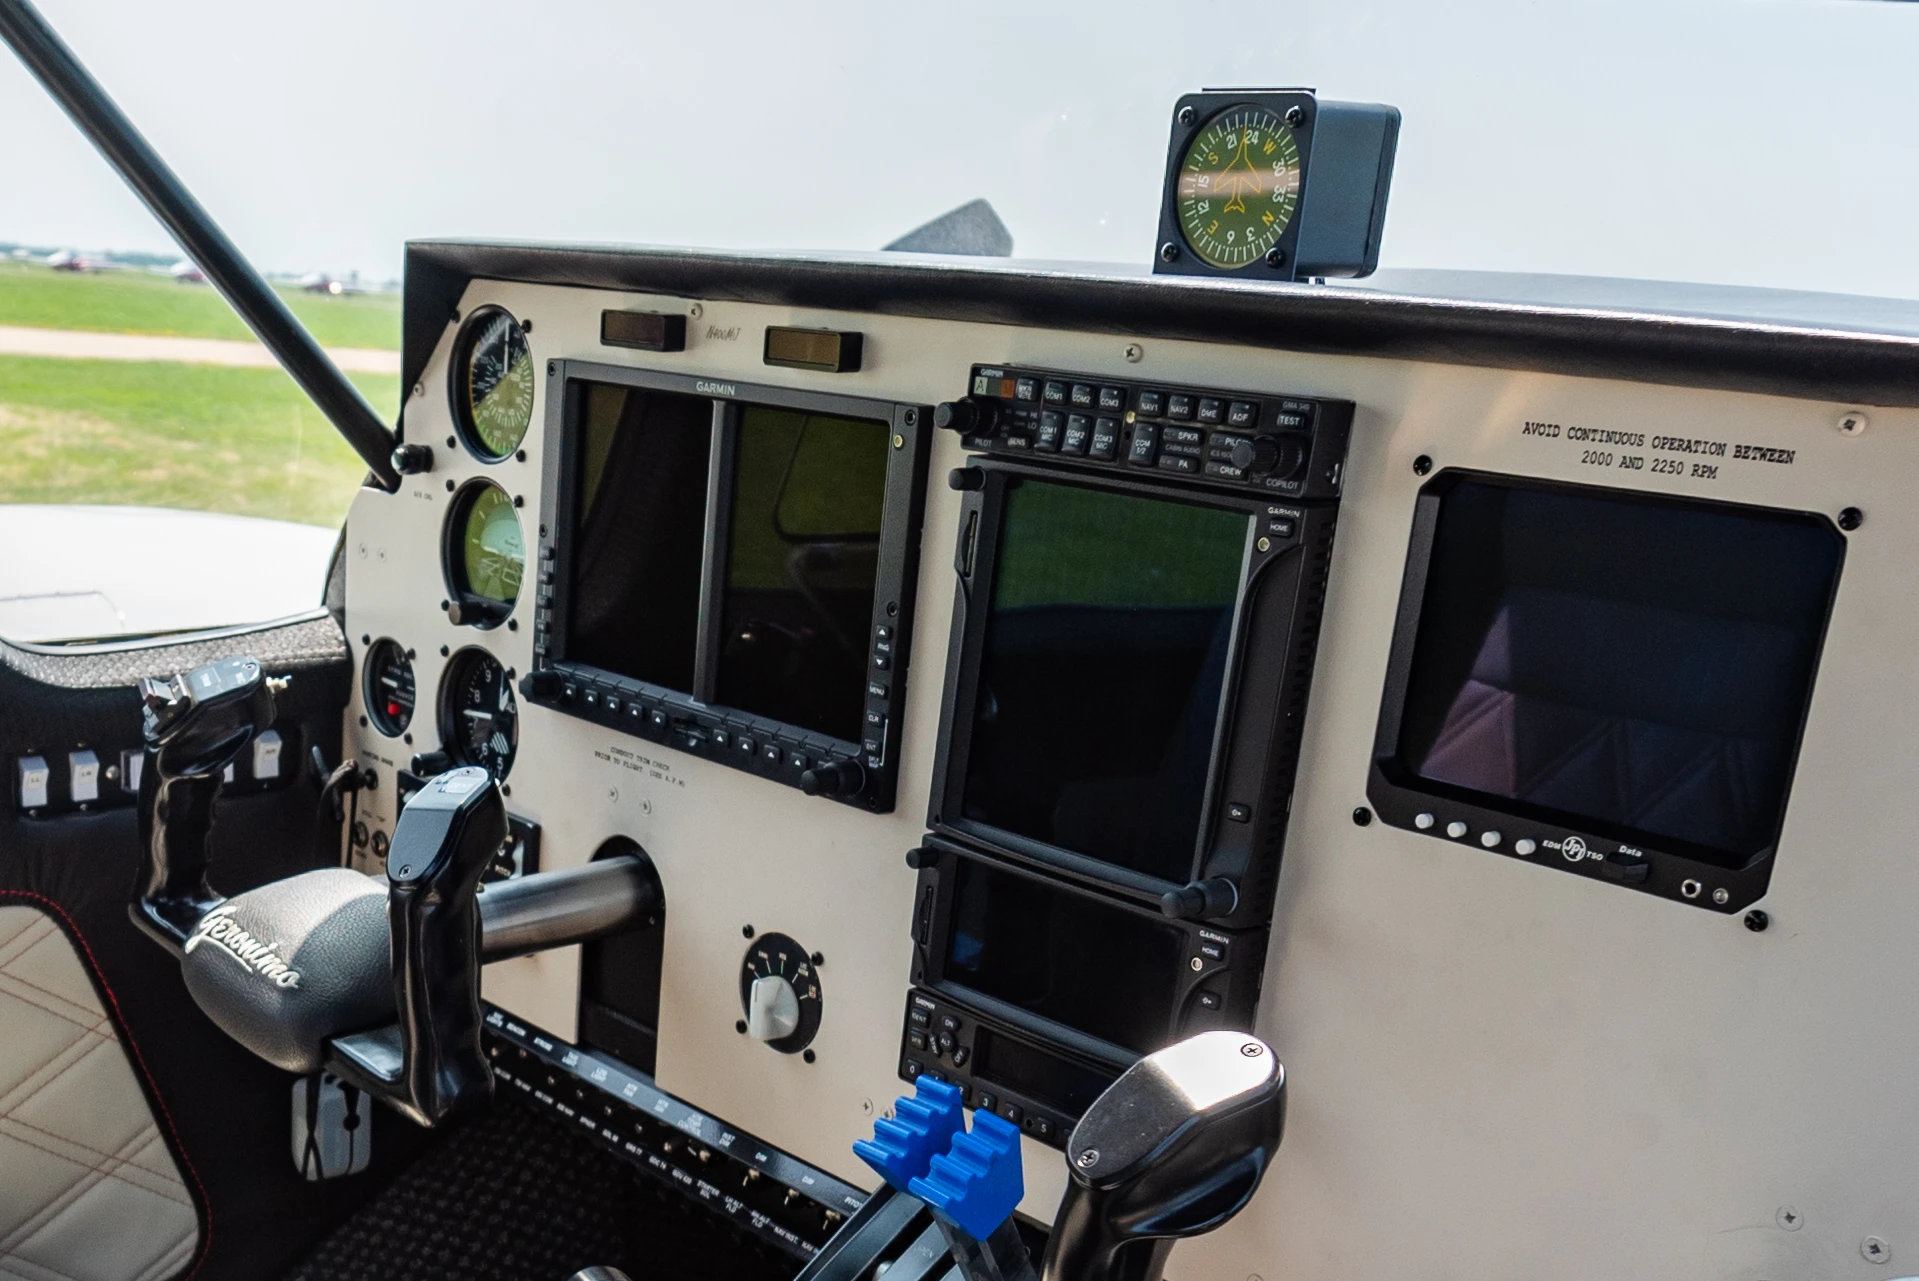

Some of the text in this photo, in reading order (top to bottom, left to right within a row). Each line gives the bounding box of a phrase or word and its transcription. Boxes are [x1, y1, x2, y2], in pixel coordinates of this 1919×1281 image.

[1226, 134, 1237, 149] 21
[1246, 130, 1259, 145] 24
[1263, 138, 1277, 154] W
[1208, 152, 1219, 165] S
[1272, 158, 1287, 177] 30
[1198, 175, 1210, 188] 15
[1272, 185, 1287, 203] 33
[1198, 199, 1210, 214] 12
[1262, 211, 1275, 226] N
[1208, 219, 1218, 234] E
[1227, 231, 1235, 243] 6
[1246, 227, 1255, 242] 3
[696, 381, 736, 396] GARMIN
[976, 379, 985, 392] A
[1045, 391, 1063, 400] COM1
[1072, 395, 1091, 404] COM2
[1100, 398, 1119, 408] COM3
[1141, 402, 1158, 412] NAV1
[1170, 406, 1189, 414] NAV2
[1201, 409, 1217, 418] DME
[1278, 416, 1300, 425] TEST
[1067, 429, 1085, 439] COM2
[1094, 433, 1113, 443] COM3
[1178, 432, 1199, 442] SPKR
[975, 438, 992, 448] PILOT
[1135, 439, 1151, 448] COM
[1522, 421, 1796, 465] AVOID CONTINUOUS OPERATION BETWEEN
[1178, 460, 1188, 468] PA
[1581, 450, 1719, 480] 2000 AND 2250 RPM
[1220, 466, 1242, 476] CREW
[1266, 478, 1298, 490] COPILOT
[1268, 506, 1300, 518] GARMIN
[1270, 523, 1288, 532] HOME
[484, 669, 492, 683] 9
[869, 684, 885, 696] MENU
[868, 714, 880, 723] CLR
[1542, 839, 1604, 861] EDM JPI TSO
[1618, 844, 1643, 858] Data
[1199, 929, 1229, 945] GARMIN
[1202, 946, 1220, 957] HOME
[944, 1018, 954, 1028] ON
[940, 1038, 951, 1046] ALT
[982, 1098, 988, 1107] 3
[1008, 1110, 1014, 1118] 4
[1041, 1124, 1047, 1134] 5
[755, 1152, 768, 1162] DIM
[802, 1176, 815, 1185] DIM
[726, 1204, 737, 1214] FLD
[752, 1218, 764, 1228] FLD
